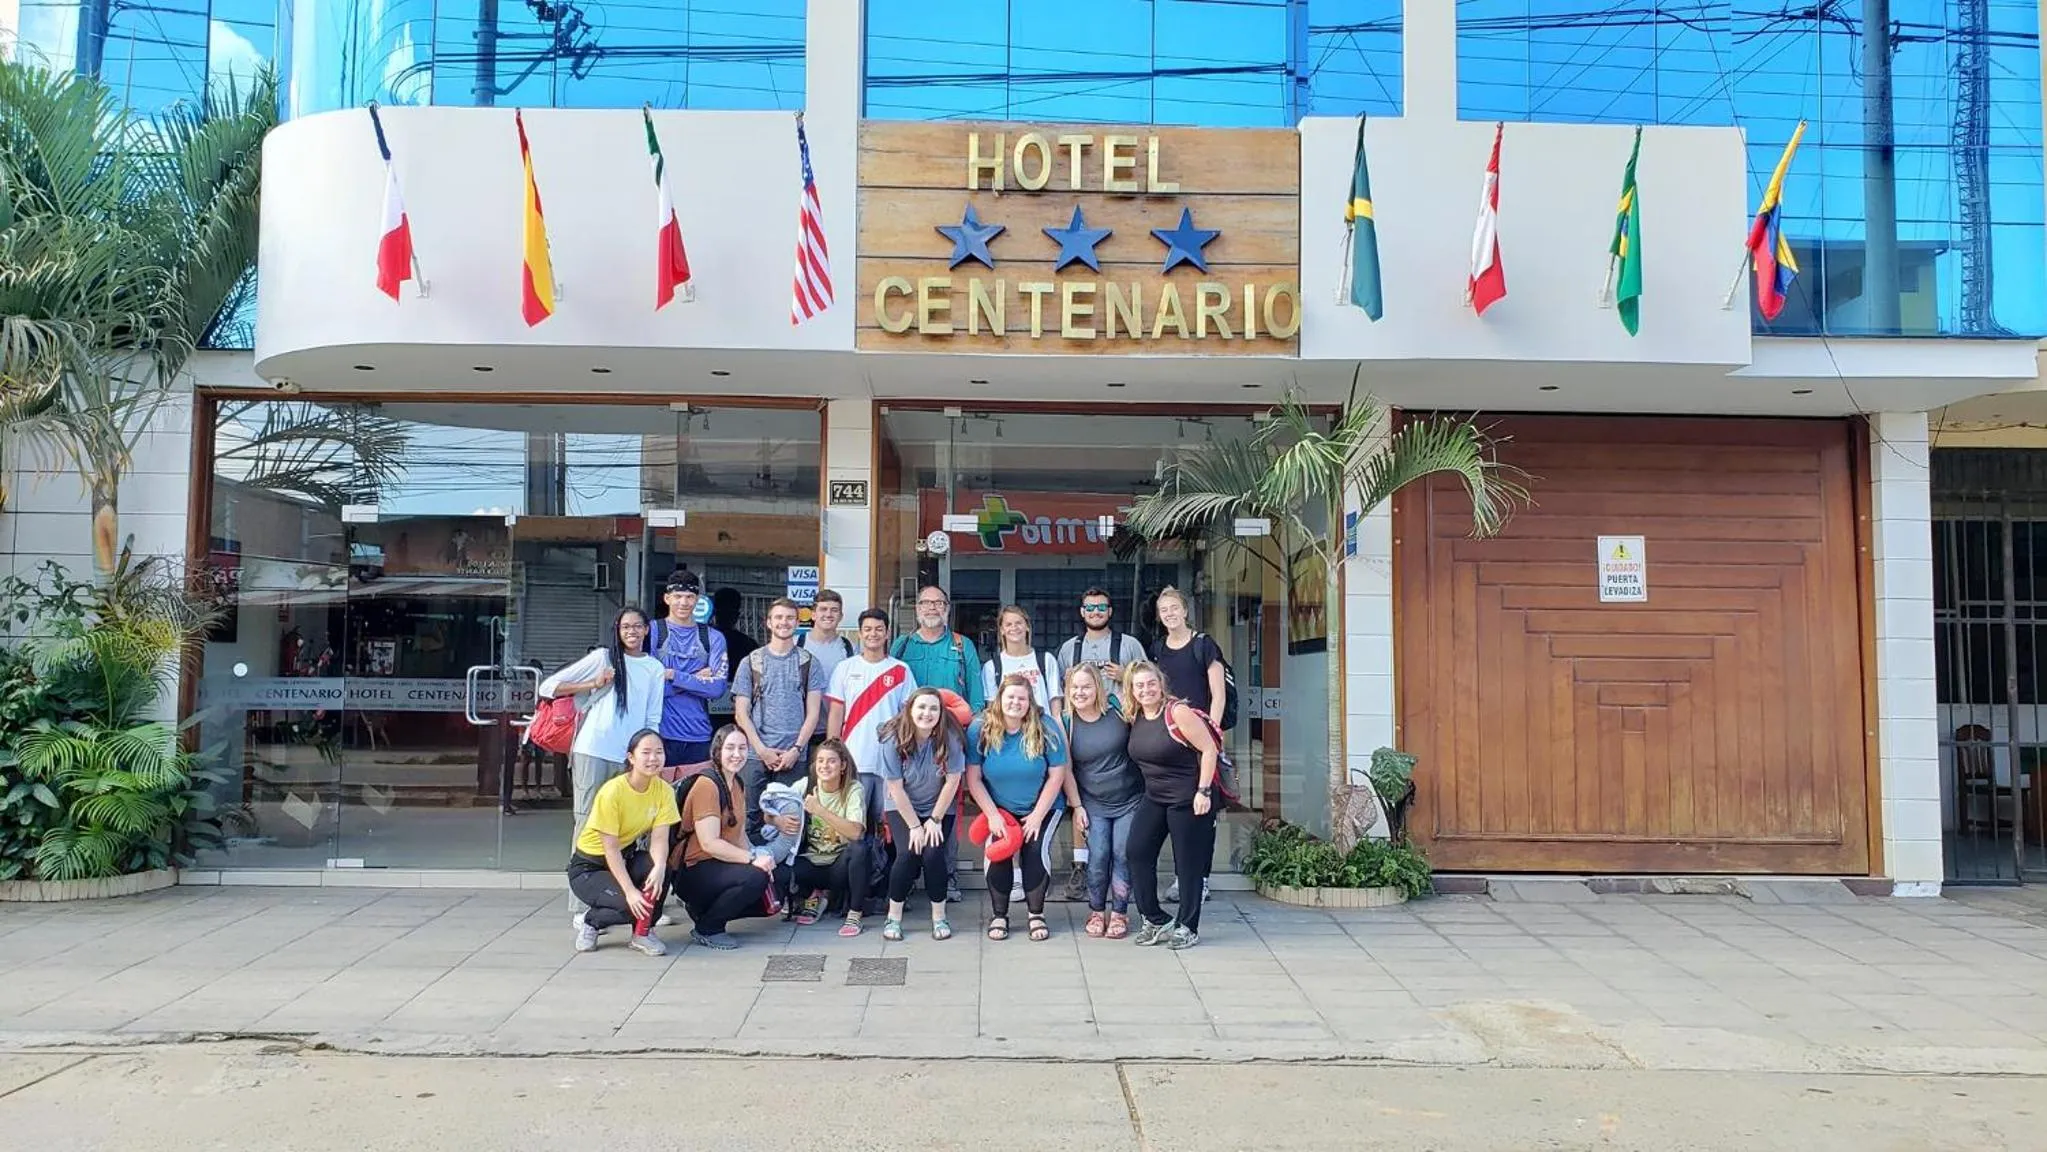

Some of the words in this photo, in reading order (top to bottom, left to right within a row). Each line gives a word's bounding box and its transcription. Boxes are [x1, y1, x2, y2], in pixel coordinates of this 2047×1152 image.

[968, 132, 1181, 194] HOTEL
[874, 275, 1302, 341] CENTENARIO
[833, 484, 864, 498] 744
[792, 568, 818, 580] VISA
[1607, 574, 1639, 584] PUERTA
[791, 588, 817, 599] VISA
[1604, 586, 1642, 596] LEVADIZA
[255, 688, 342, 700] CENTENARIO
[350, 688, 395, 700] HOTEL
[407, 689, 498, 702] CENTENIO
